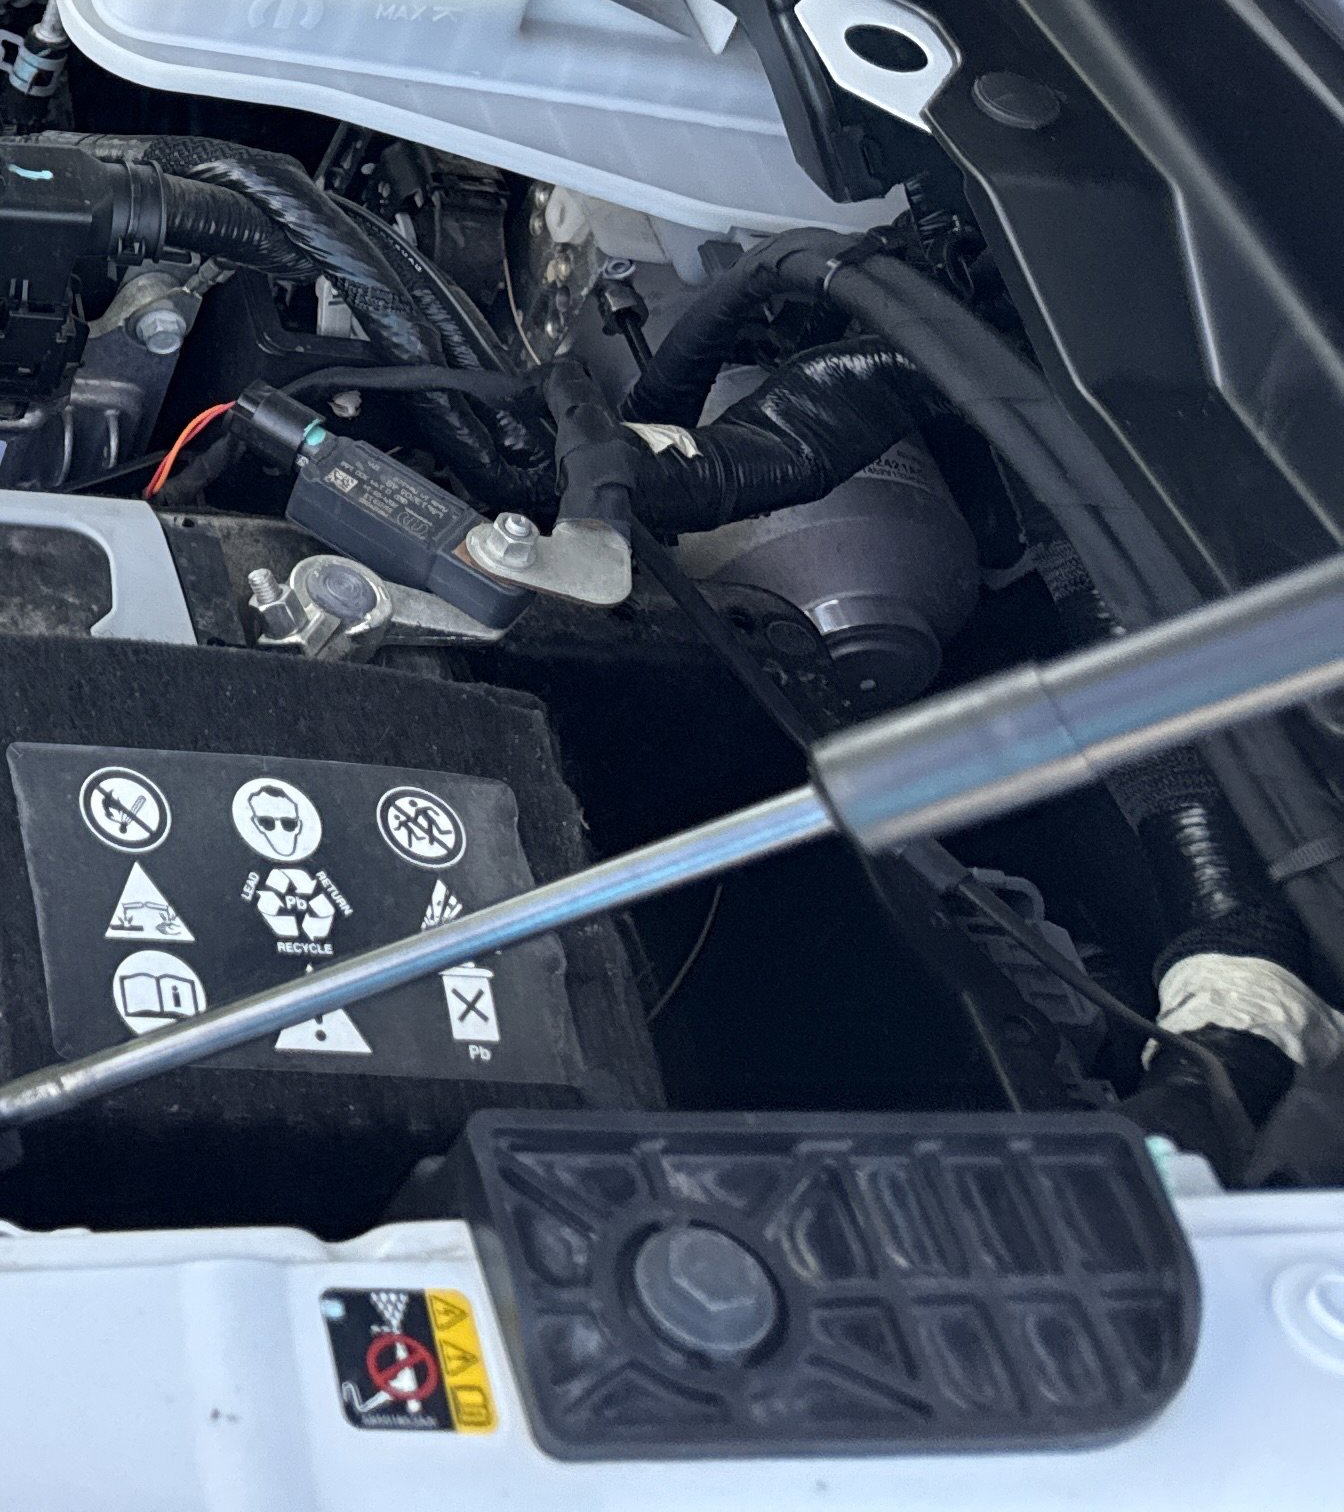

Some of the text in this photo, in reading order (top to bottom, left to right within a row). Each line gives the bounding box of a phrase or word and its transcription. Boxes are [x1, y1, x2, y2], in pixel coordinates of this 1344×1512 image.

[375, 2, 427, 22] MAX
[241, 871, 260, 902] LEAD
[315, 870, 354, 917] RETURN
[285, 895, 308, 911] Pb
[276, 941, 333, 955] RECYCLE
[468, 1044, 492, 1061] Pb
